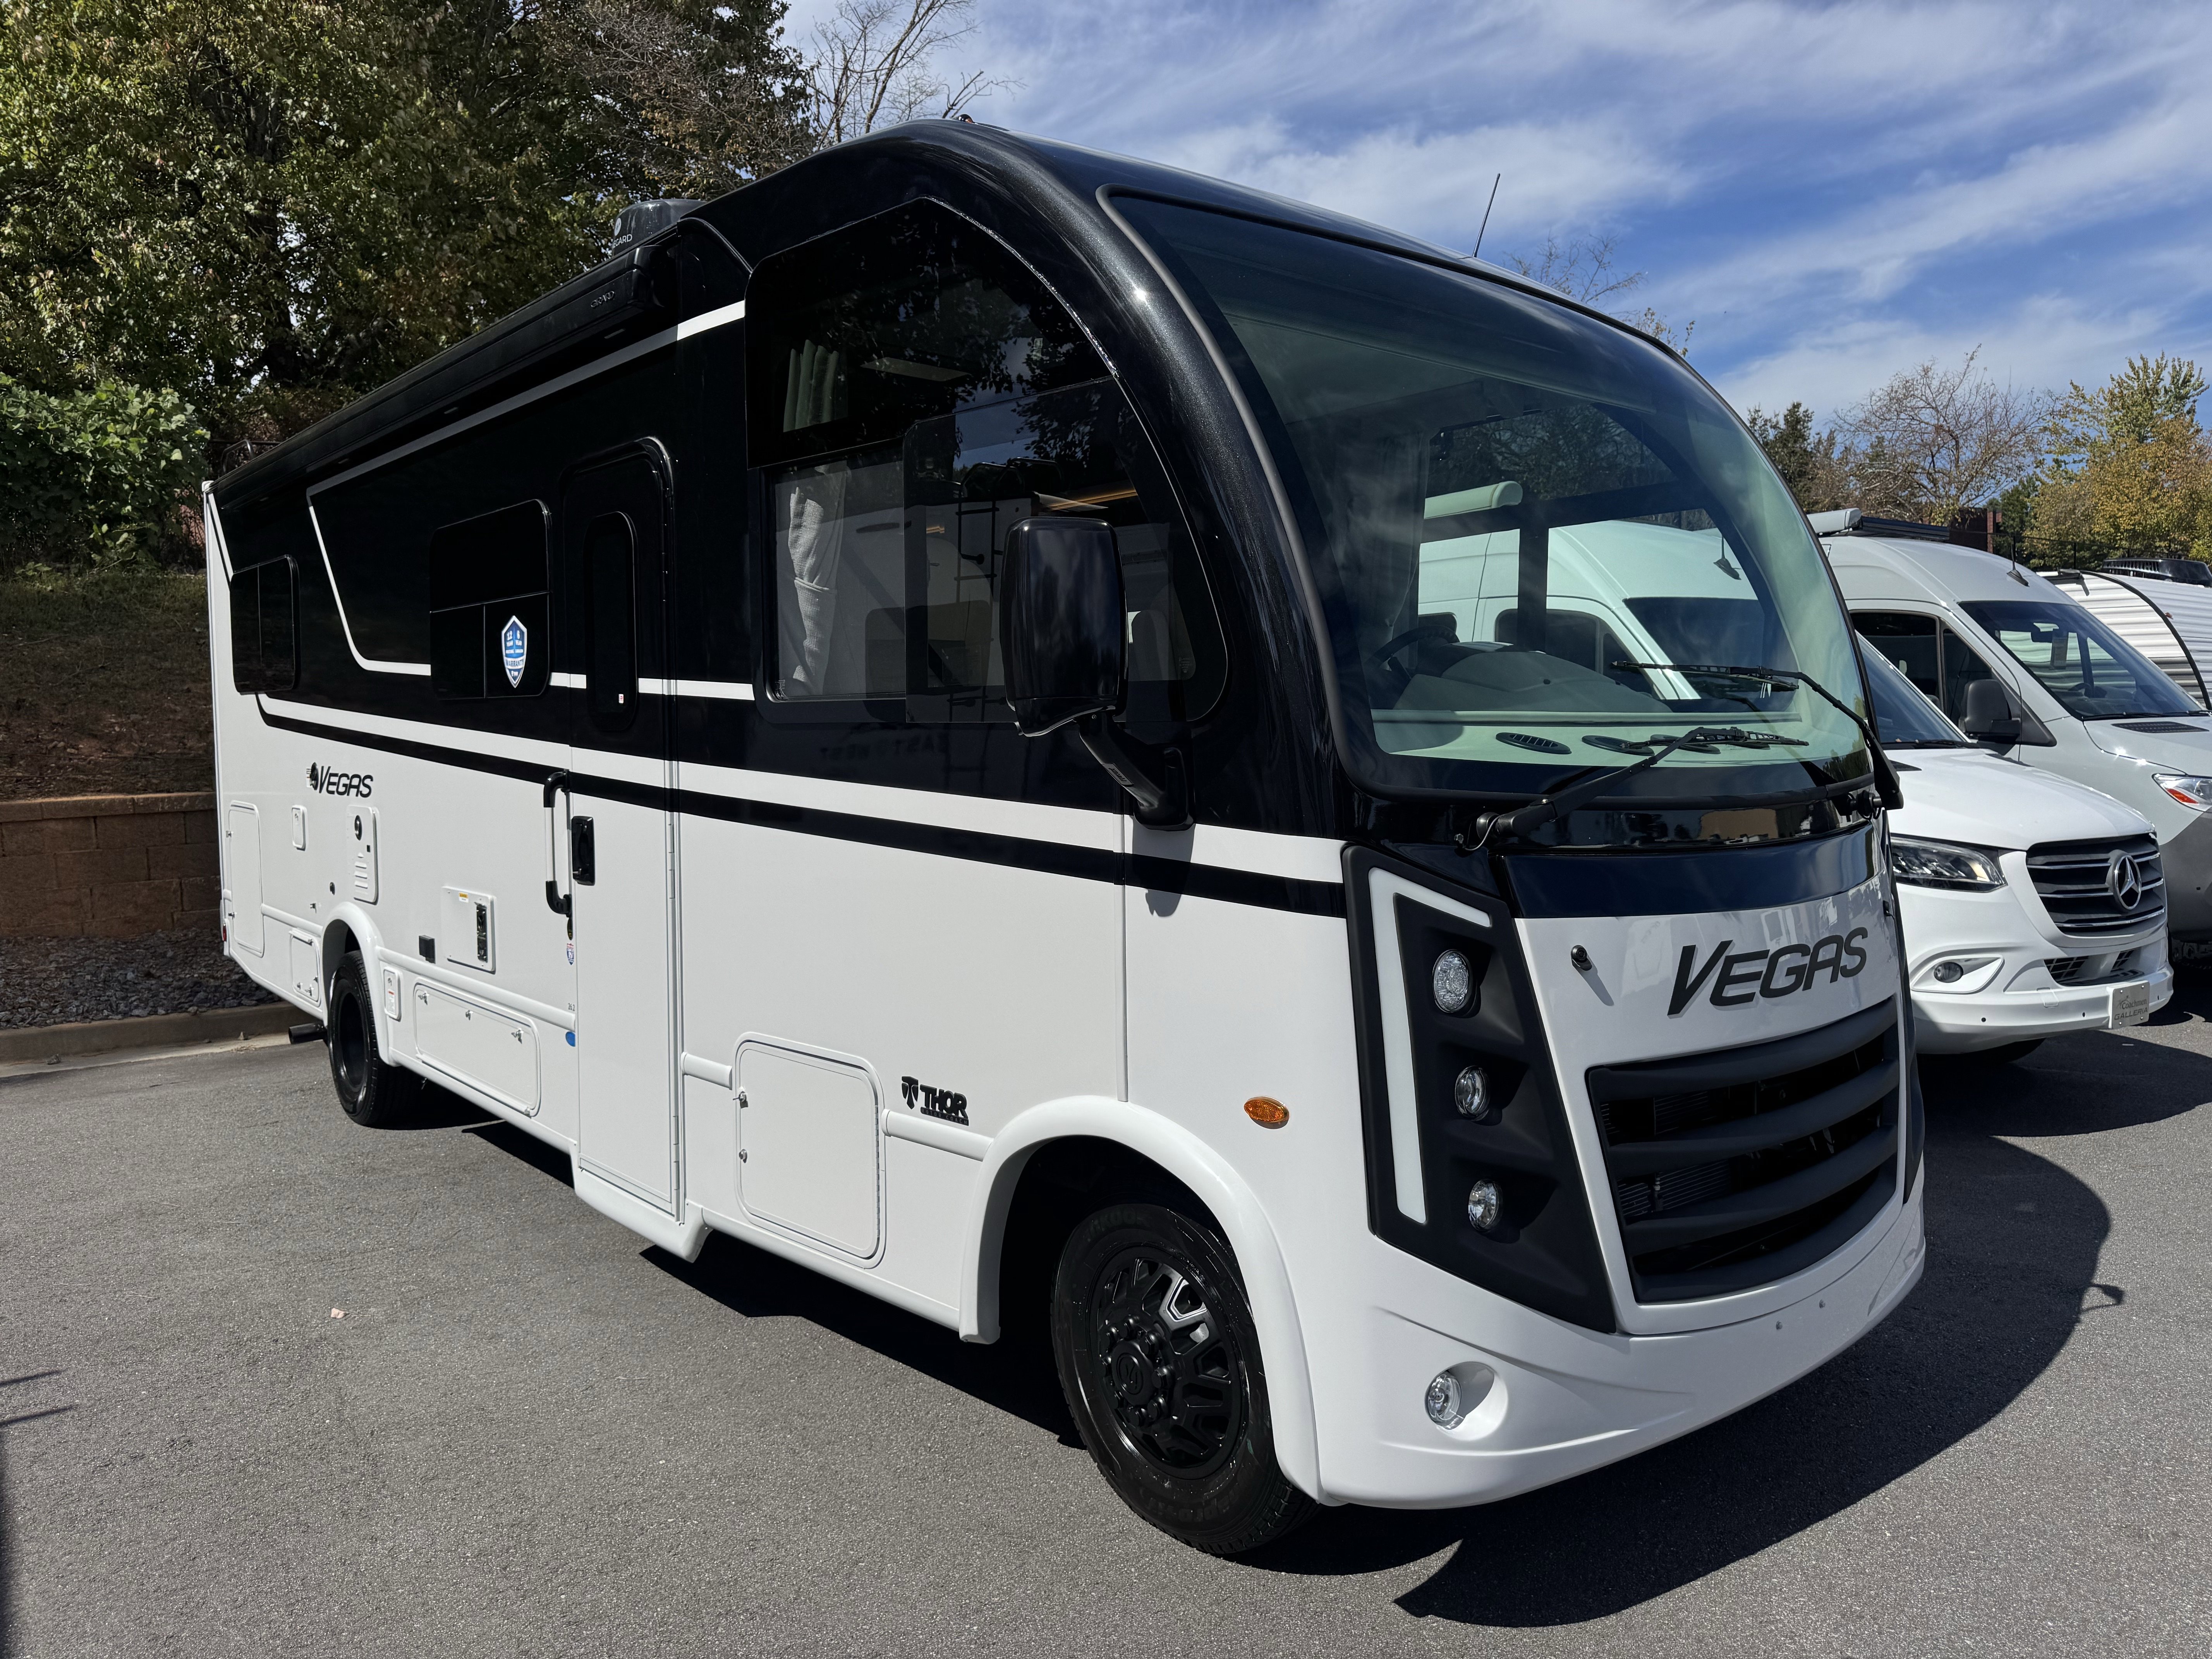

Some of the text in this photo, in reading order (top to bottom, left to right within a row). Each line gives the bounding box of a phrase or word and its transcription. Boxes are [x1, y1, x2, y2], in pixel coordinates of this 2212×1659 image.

[319, 766, 373, 798] VEGAS
[1667, 927, 1868, 1016] VEGAS
[2114, 1007, 2148, 1020] GALLERIA
[2122, 999, 2147, 1010] Coachmen
[920, 1084, 968, 1119] THOR
[946, 1115, 967, 1125] COACH
